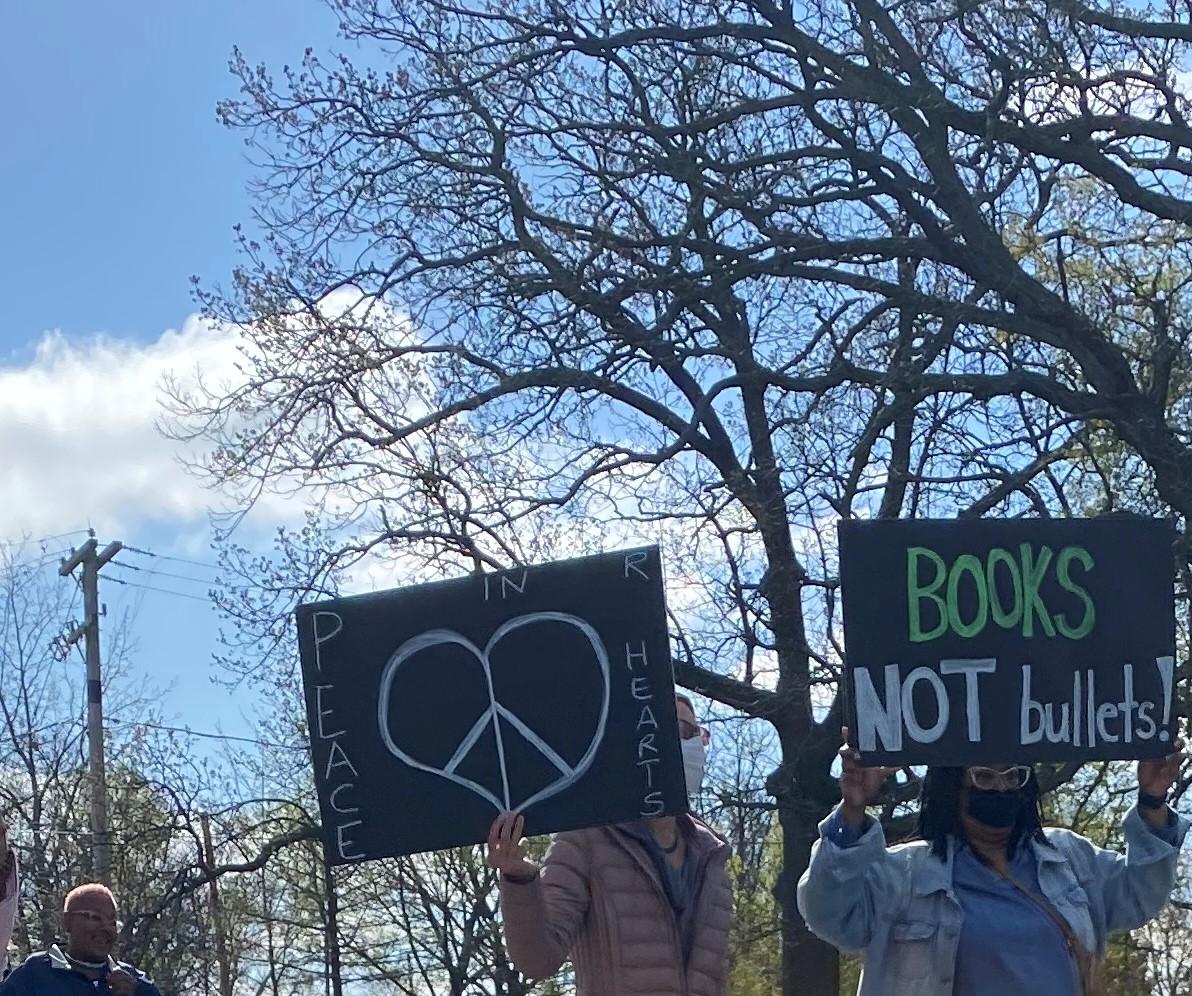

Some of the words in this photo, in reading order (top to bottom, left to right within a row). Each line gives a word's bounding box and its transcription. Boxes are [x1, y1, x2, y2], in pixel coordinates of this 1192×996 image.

[483, 570, 528, 601] IN
[623, 551, 650, 581] R
[907, 543, 1096, 643] BOOKS
[311, 611, 366, 861] PEACE
[625, 640, 664, 816] HEARTS
[853, 657, 997, 752] NOT
[1019, 655, 1175, 748] bullets!
